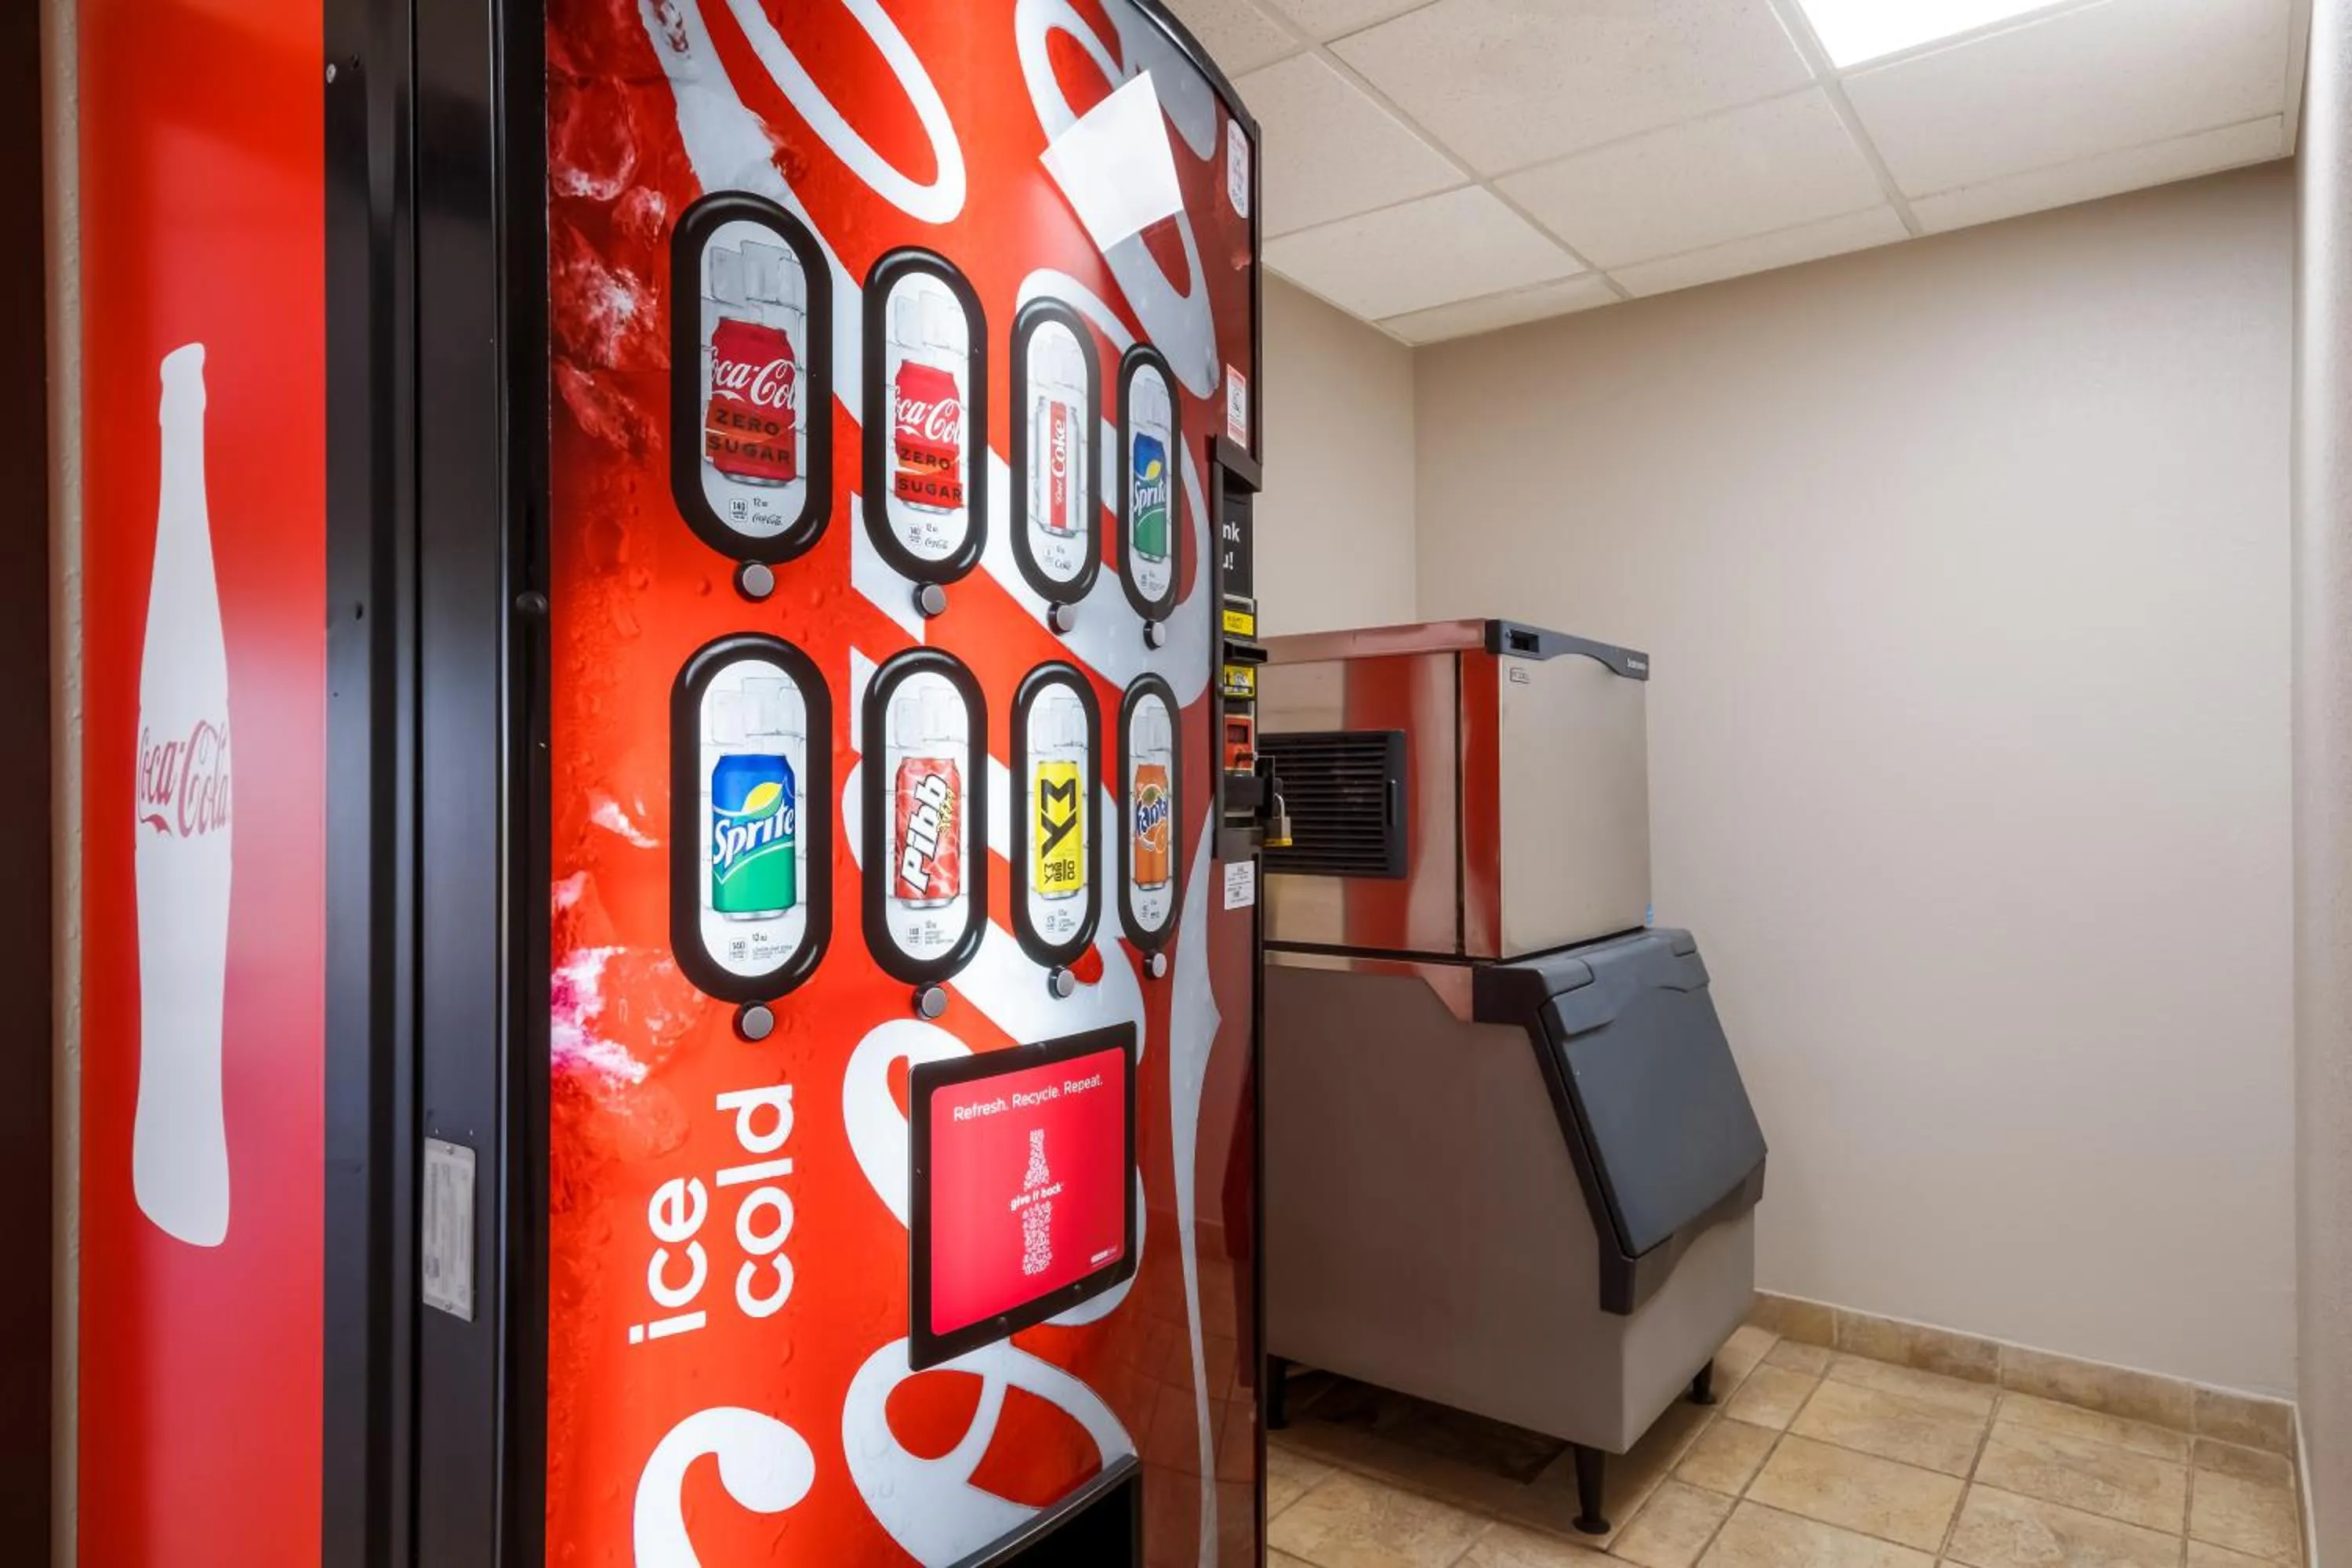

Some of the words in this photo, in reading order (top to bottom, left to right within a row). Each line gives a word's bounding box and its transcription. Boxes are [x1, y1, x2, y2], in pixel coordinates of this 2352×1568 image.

[714, 408, 781, 437] ZERO
[1051, 419, 1065, 478] Coke
[707, 435, 791, 465] SUGAR
[900, 448, 951, 471] ZERO
[898, 477, 963, 502] SUGAR
[136, 719, 229, 838] Coca-Cola
[713, 799, 795, 869] Sprite
[900, 774, 947, 894] Pibb
[953, 1098, 1008, 1123] Refresh.
[1011, 1085, 1060, 1109] Recycle.
[1064, 1074, 1103, 1096] Repeat.
[715, 1083, 794, 1318] cold
[1010, 1194, 1031, 1212] give
[629, 1177, 708, 1345] ice
